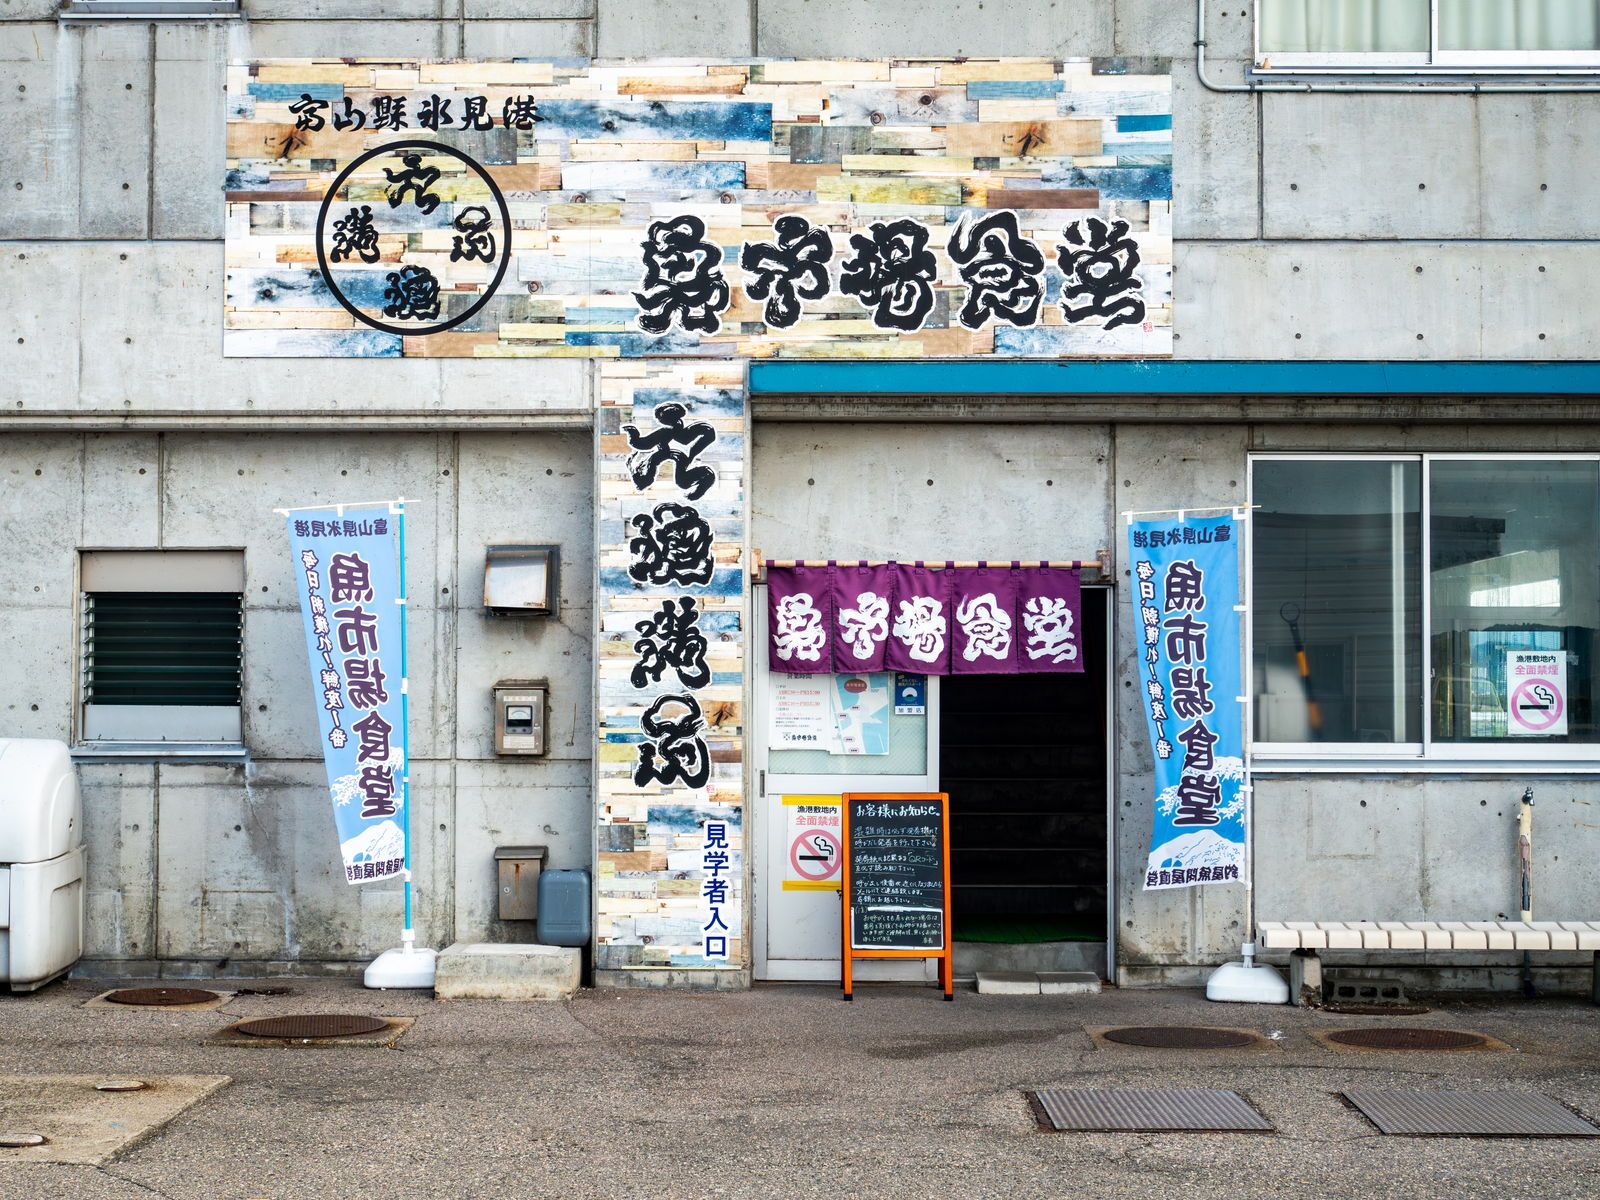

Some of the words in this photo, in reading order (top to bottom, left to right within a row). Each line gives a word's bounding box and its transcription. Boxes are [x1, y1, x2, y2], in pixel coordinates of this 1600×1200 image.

[636, 210, 1146, 332] 魚市場食堂
[773, 592, 1077, 664] 魚市場食堂
[1516, 655, 1557, 663] 漁港敷地内
[1515, 664, 1559, 675] 全面禁煙
[797, 805, 837, 814] 漁港敷地内
[796, 815, 840, 827] 全面禁煙
[703, 823, 730, 957] 見学者入口
